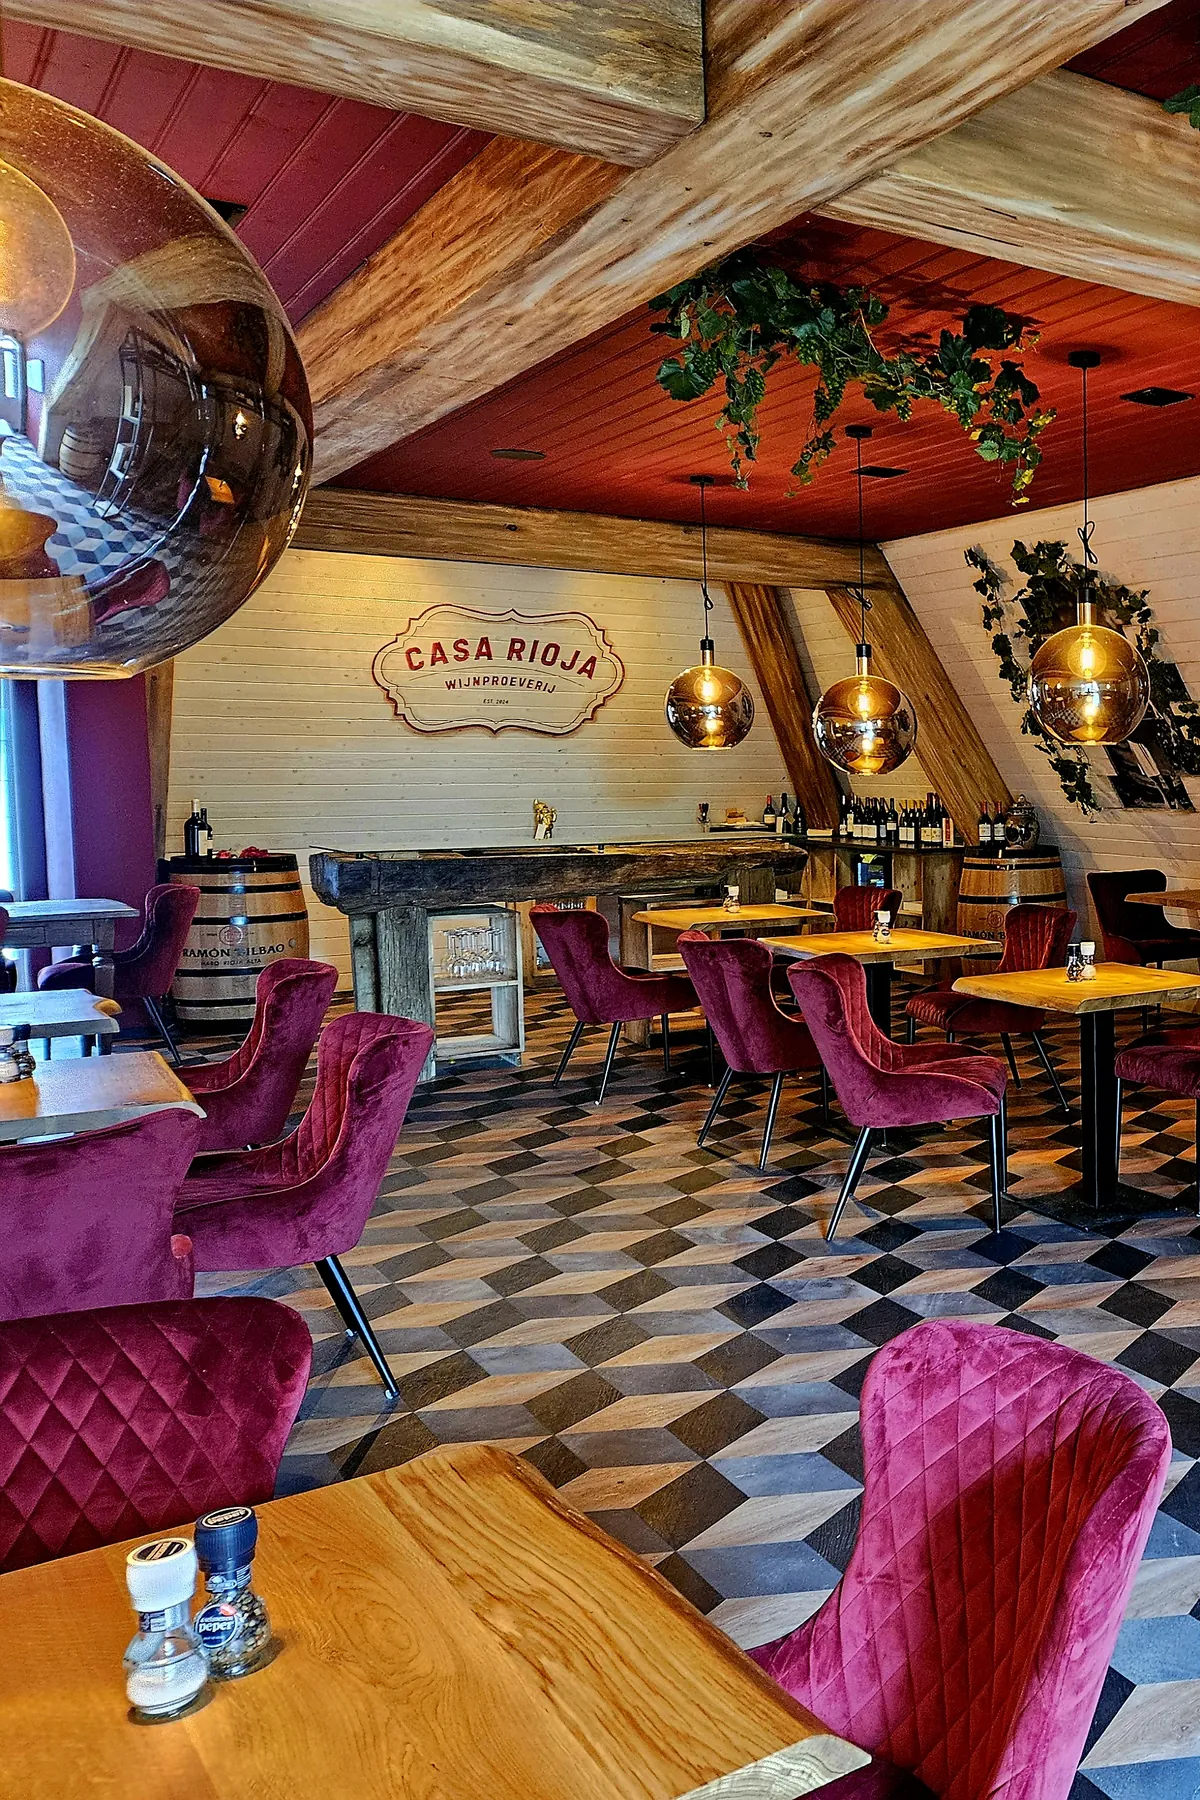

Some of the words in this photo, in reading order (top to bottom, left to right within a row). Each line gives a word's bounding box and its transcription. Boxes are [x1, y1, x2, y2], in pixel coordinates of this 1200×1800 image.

[405, 636, 493, 671] CASA
[506, 638, 598, 680] RIOJA
[445, 676, 557, 693] WIJNPROEVERIJ
[182, 947, 230, 957] RAMÓN
